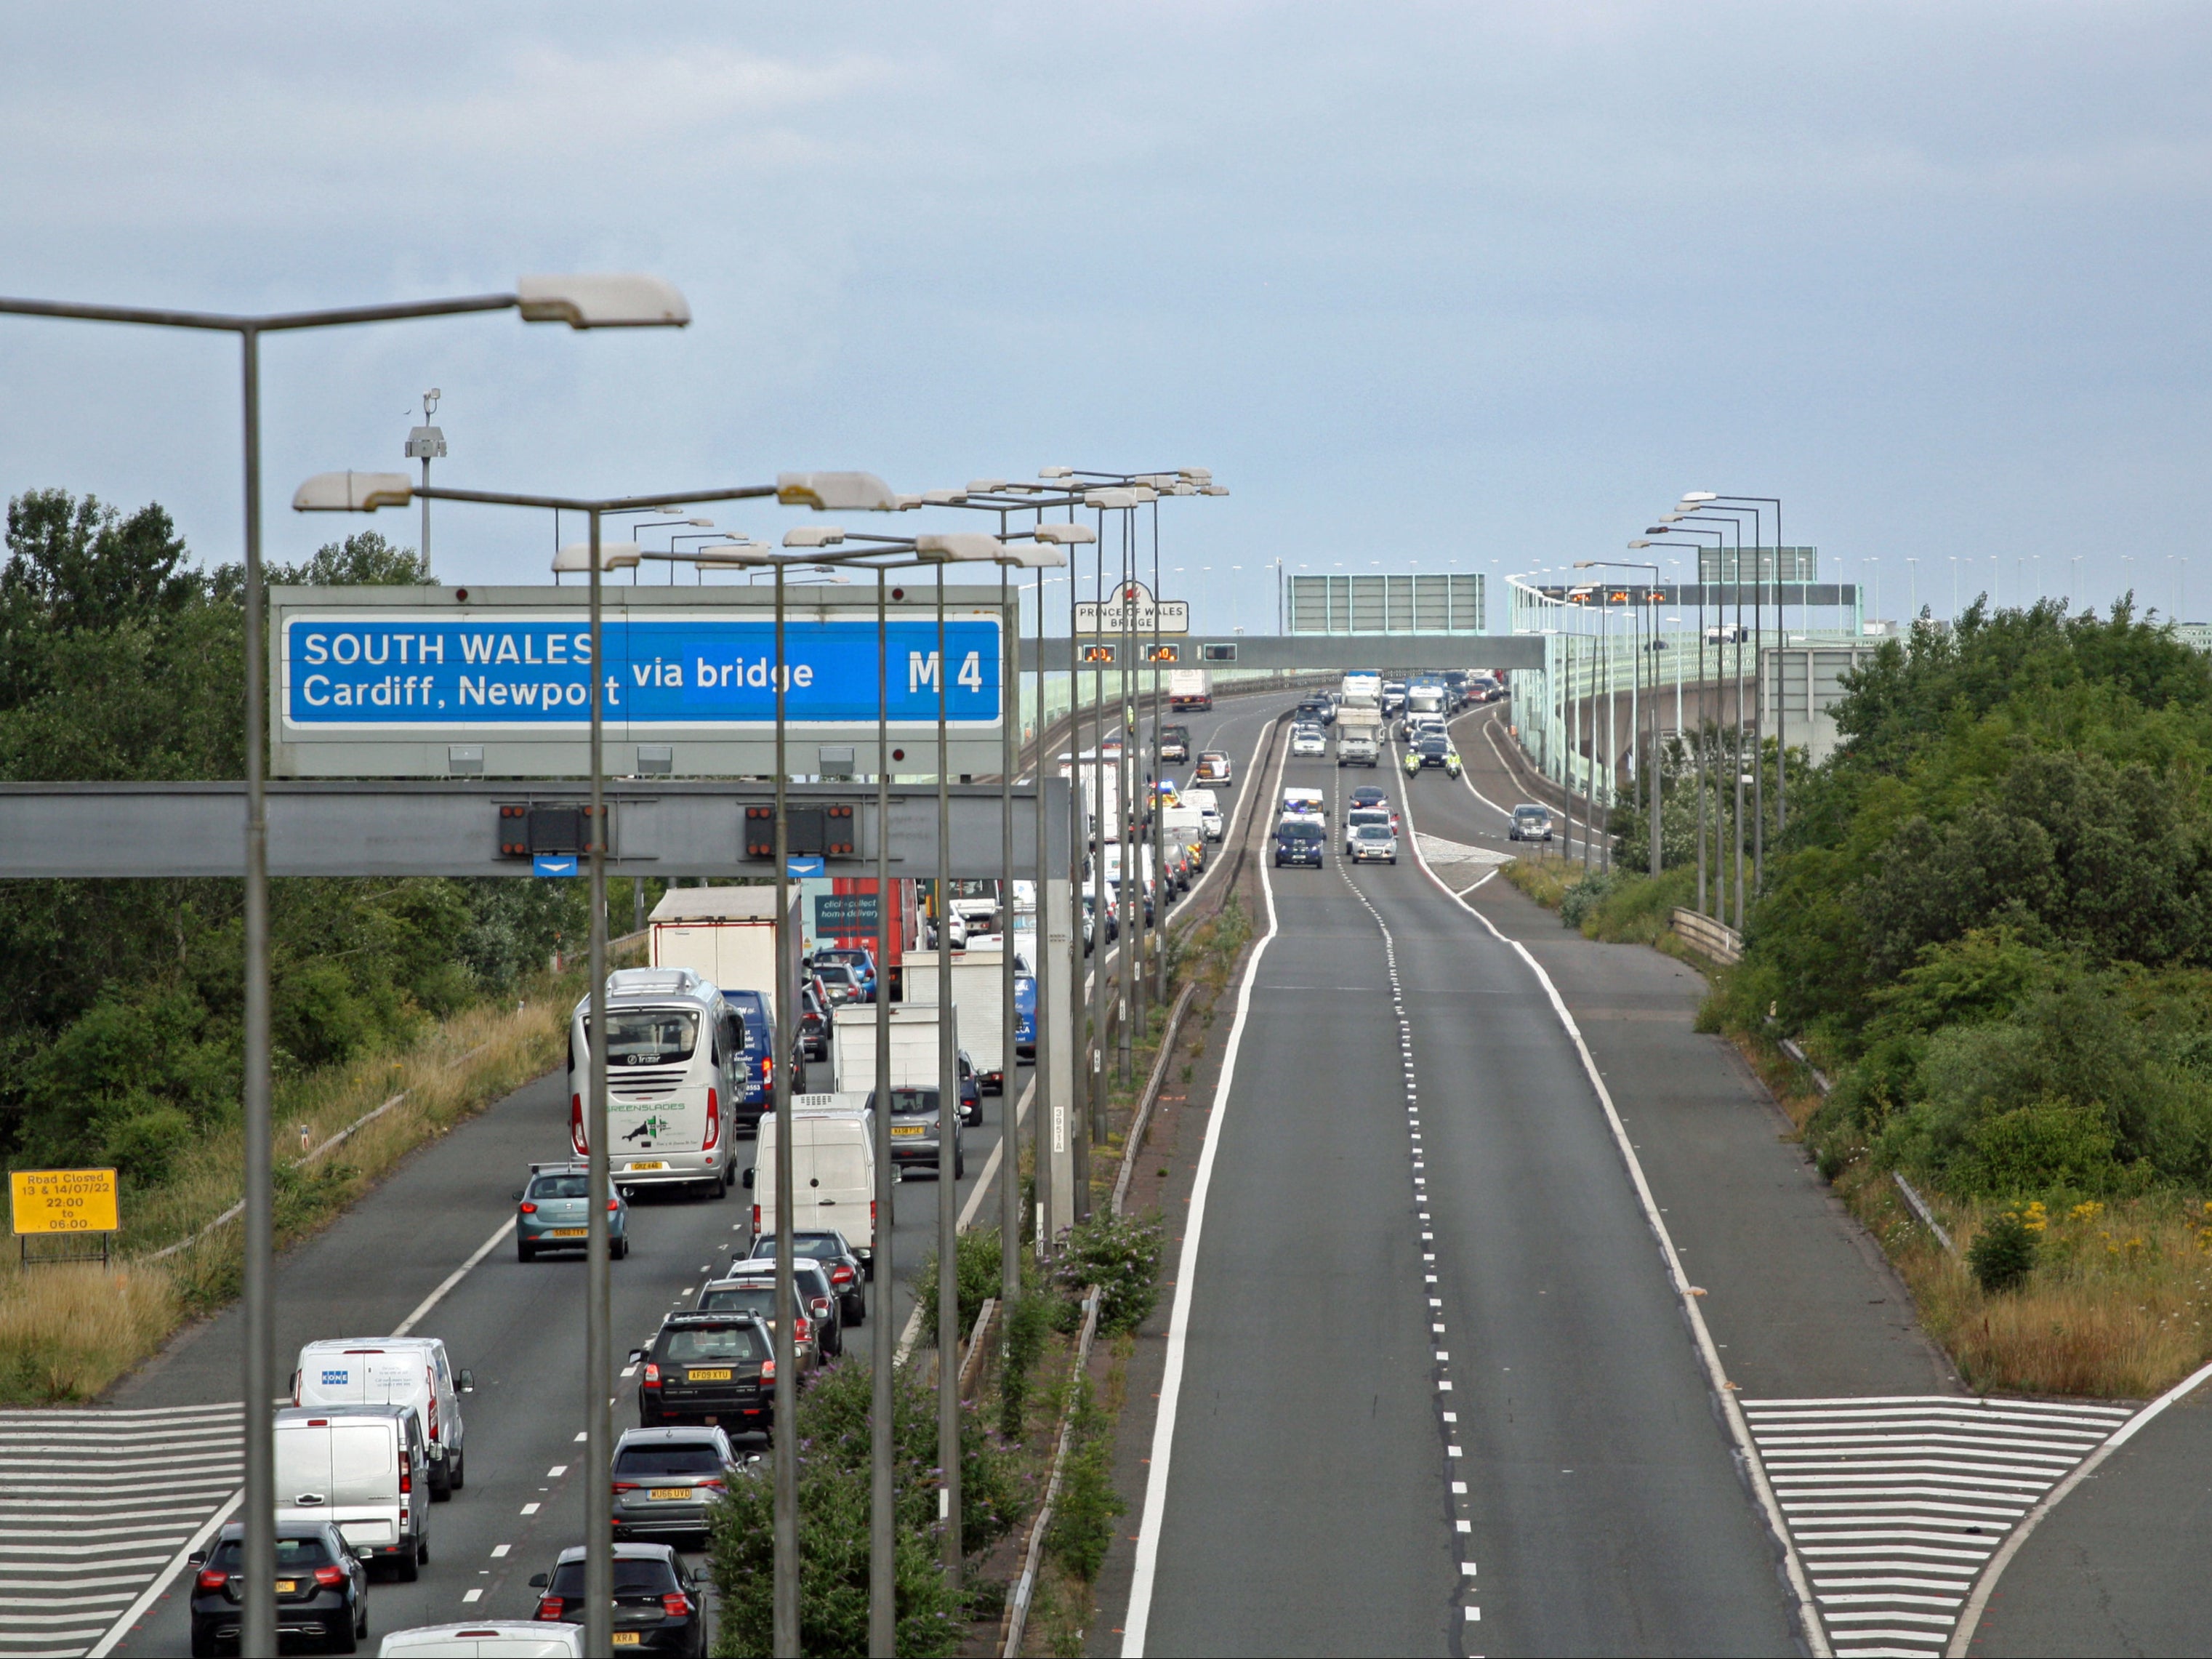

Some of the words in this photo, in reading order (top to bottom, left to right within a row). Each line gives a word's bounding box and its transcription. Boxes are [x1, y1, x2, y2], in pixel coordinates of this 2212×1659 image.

[304, 633, 443, 664] SOUTH
[459, 633, 592, 664] WALES
[632, 657, 683, 686] via
[697, 657, 813, 692] bridge
[909, 651, 939, 692] M
[957, 651, 982, 692] 4
[303, 674, 446, 709] Cardiff,
[459, 675, 619, 710] Newpot
[28, 1175, 57, 1184] Road
[63, 1173, 104, 1183] Closed
[23, 1186, 35, 1195] 13
[55, 1184, 110, 1194] 14/07/22
[47, 1198, 84, 1207] 22:00
[49, 1220, 87, 1229] 06:00
[322, 1373, 347, 1382] KONE
